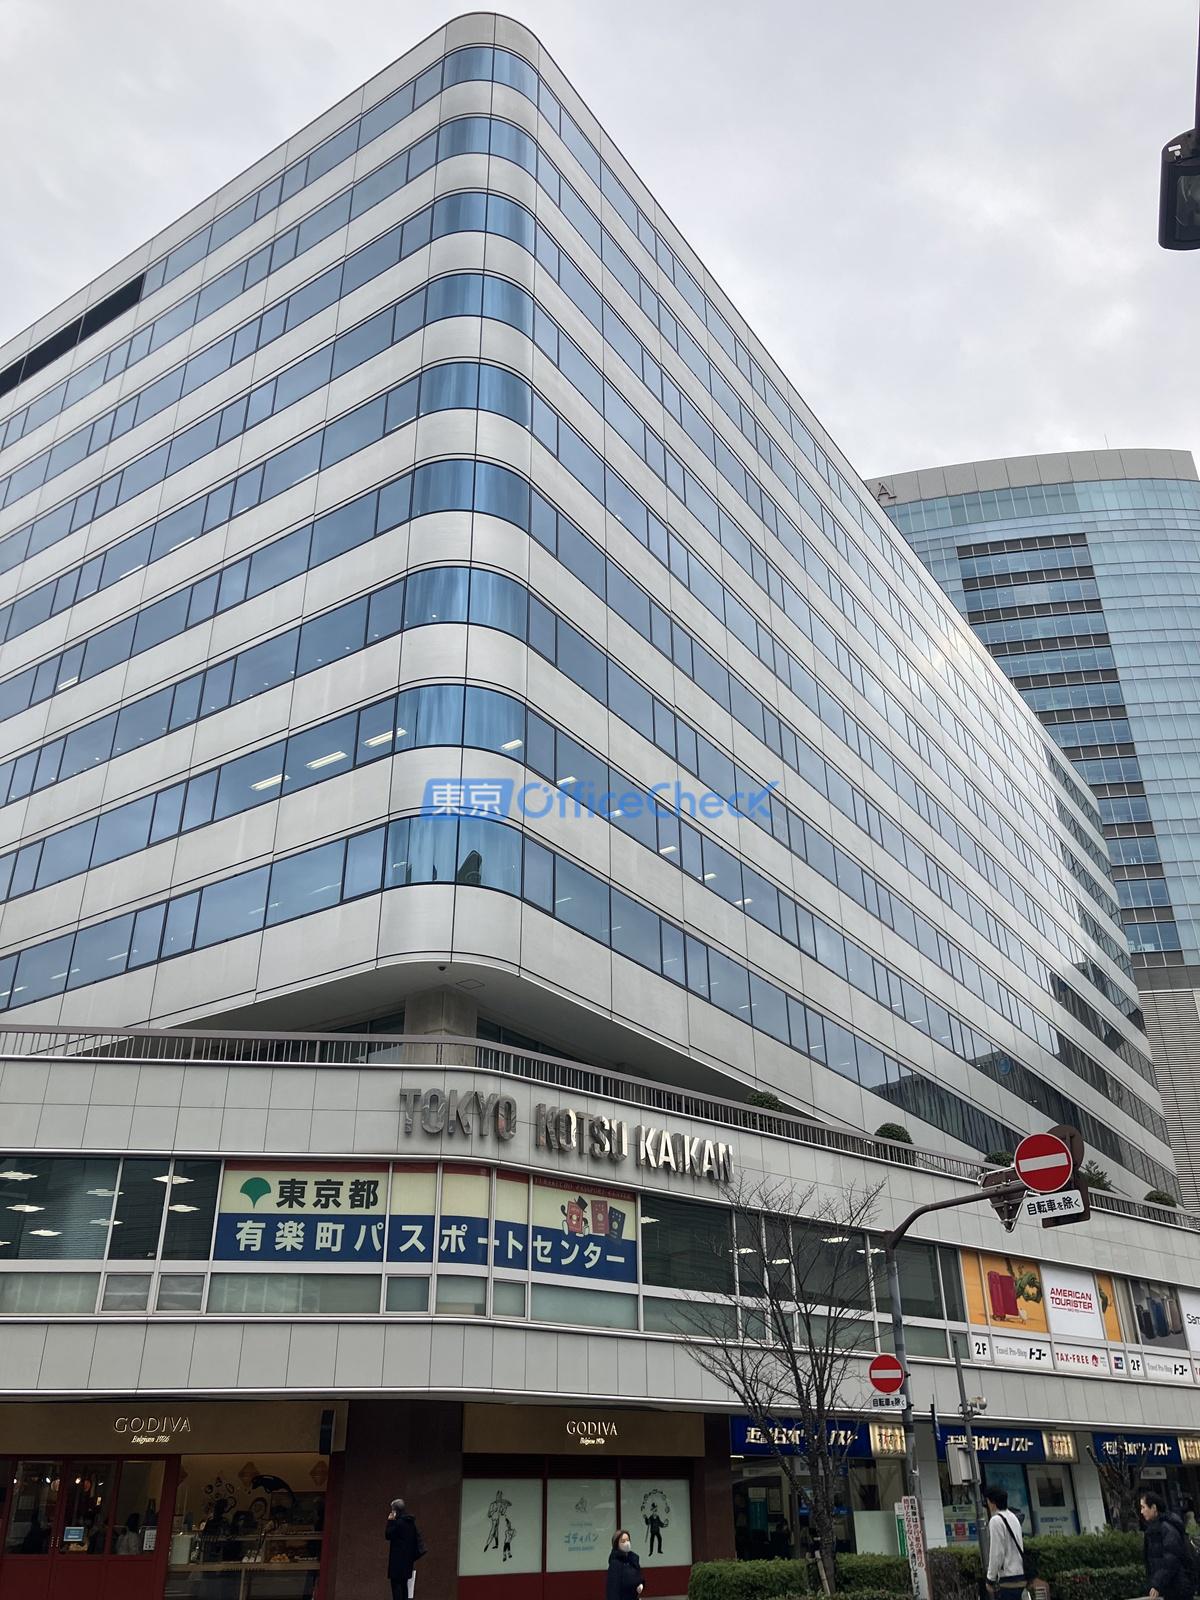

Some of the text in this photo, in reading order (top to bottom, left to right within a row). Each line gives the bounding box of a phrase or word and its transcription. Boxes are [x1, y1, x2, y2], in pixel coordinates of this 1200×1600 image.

[400, 1088, 734, 1183] TOKYO KOTSU KAIKAN
[276, 1178, 379, 1210] 東京都
[1026, 1196, 1081, 1216] 自転車を除く
[235, 1220, 625, 1270] 有楽町パスポートセンター
[1050, 1287, 1092, 1301] AMERICAN
[1050, 1296, 1093, 1310] TOURISTER
[975, 1342, 987, 1355] 2F
[1029, 1347, 1047, 1360] トコー
[1130, 1359, 1141, 1371] 2F
[1174, 1364, 1188, 1375] トコー
[114, 1417, 191, 1433] GODIVA
[566, 1420, 618, 1436] GODIVA
[745, 1427, 859, 1446] 近日本リスト
